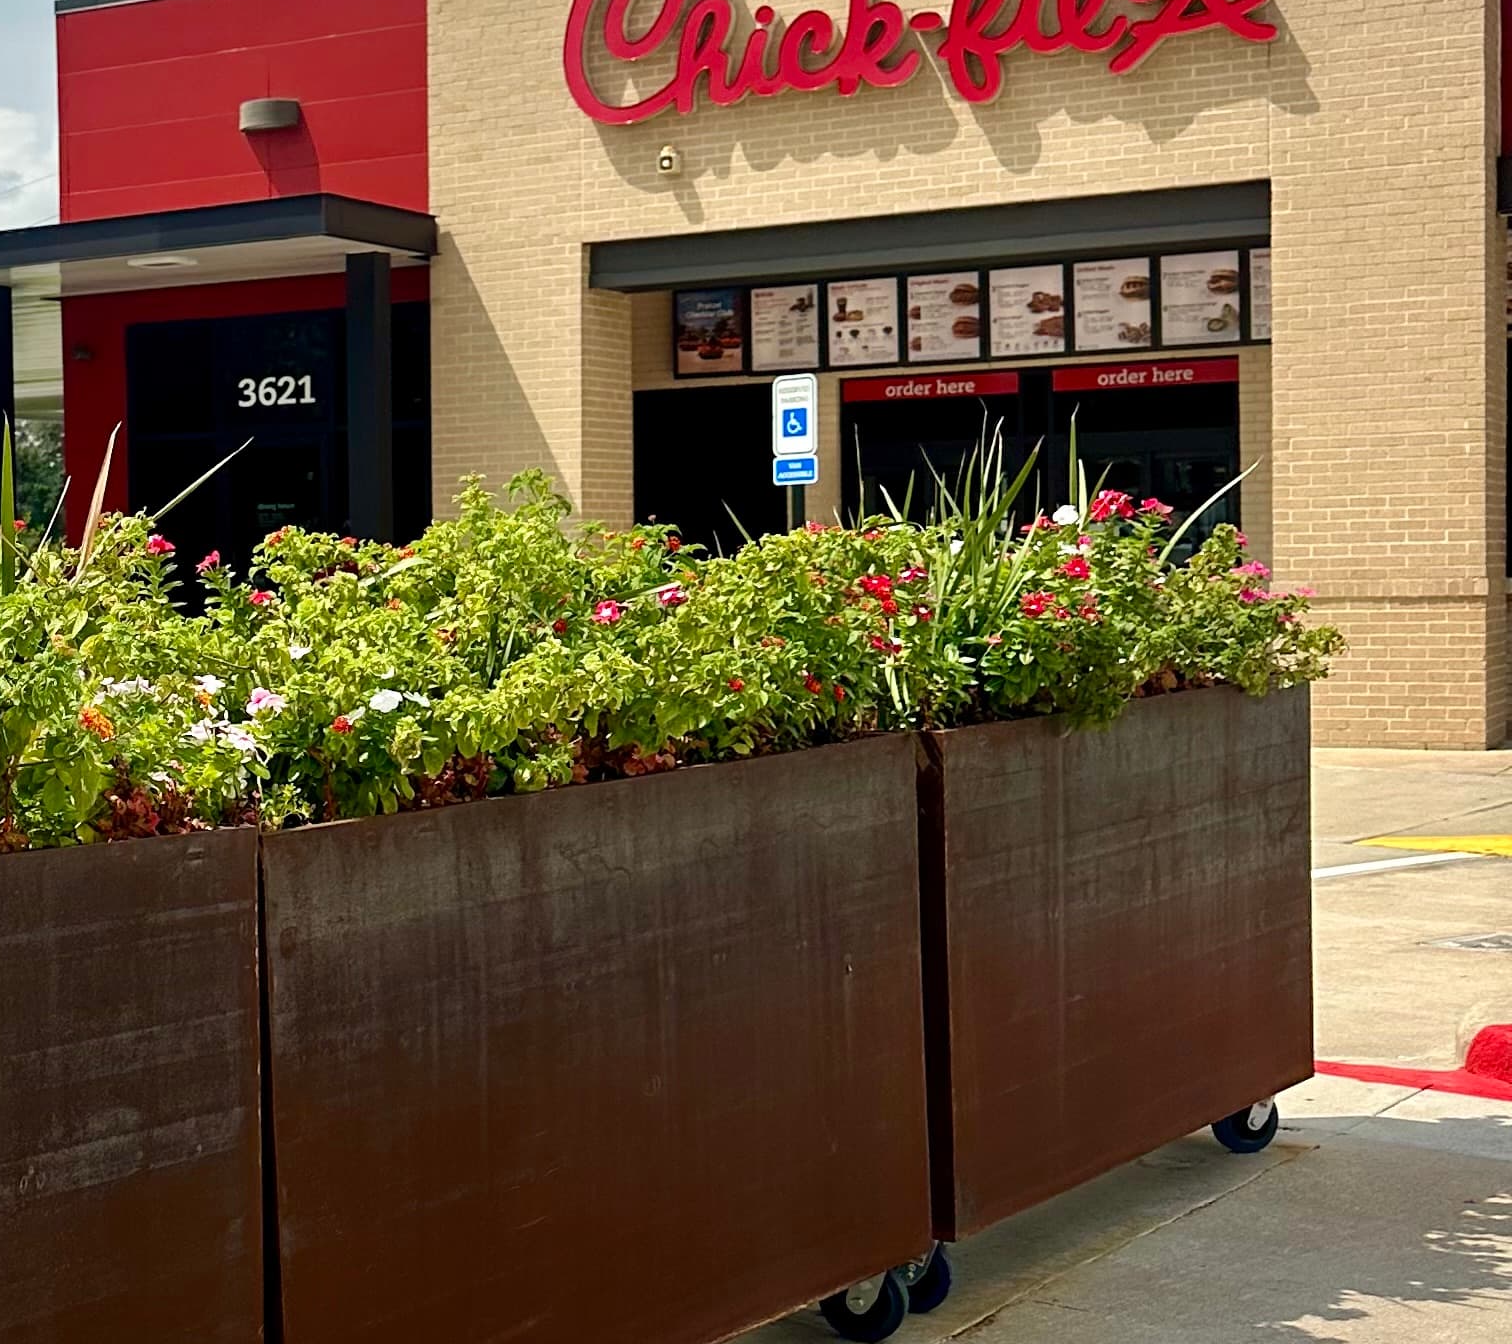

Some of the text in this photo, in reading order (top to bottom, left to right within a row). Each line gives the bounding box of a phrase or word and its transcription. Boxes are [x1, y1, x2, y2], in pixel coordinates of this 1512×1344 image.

[1097, 366, 1194, 386] order here
[238, 375, 316, 408] 3621
[885, 379, 976, 397] order here
